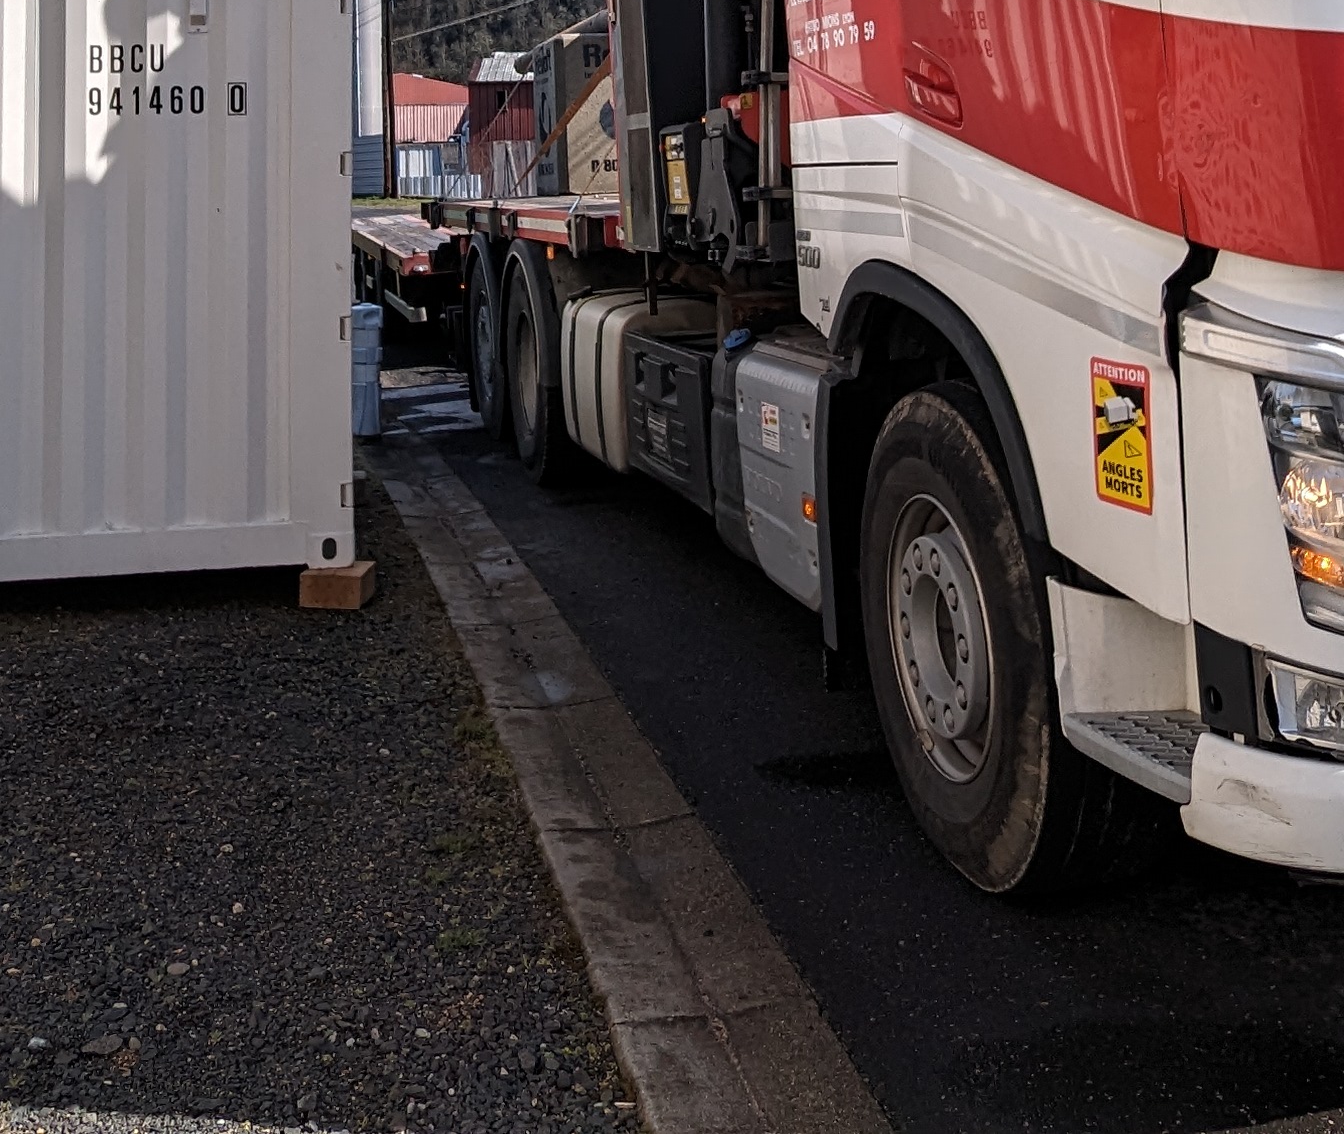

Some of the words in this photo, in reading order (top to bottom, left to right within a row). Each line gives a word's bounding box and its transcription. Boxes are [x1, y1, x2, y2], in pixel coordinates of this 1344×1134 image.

[833, 28, 845, 47] 90
[848, 24, 859, 44] 79
[863, 20, 875, 41] 59
[89, 43, 165, 73] BBCU
[88, 85, 205, 116] 941460
[229, 84, 245, 114] 0
[798, 244, 821, 269] 500
[1093, 362, 1145, 383] ATTENTION
[1102, 459, 1143, 483] ANGLES
[1105, 476, 1143, 499] MORTS
